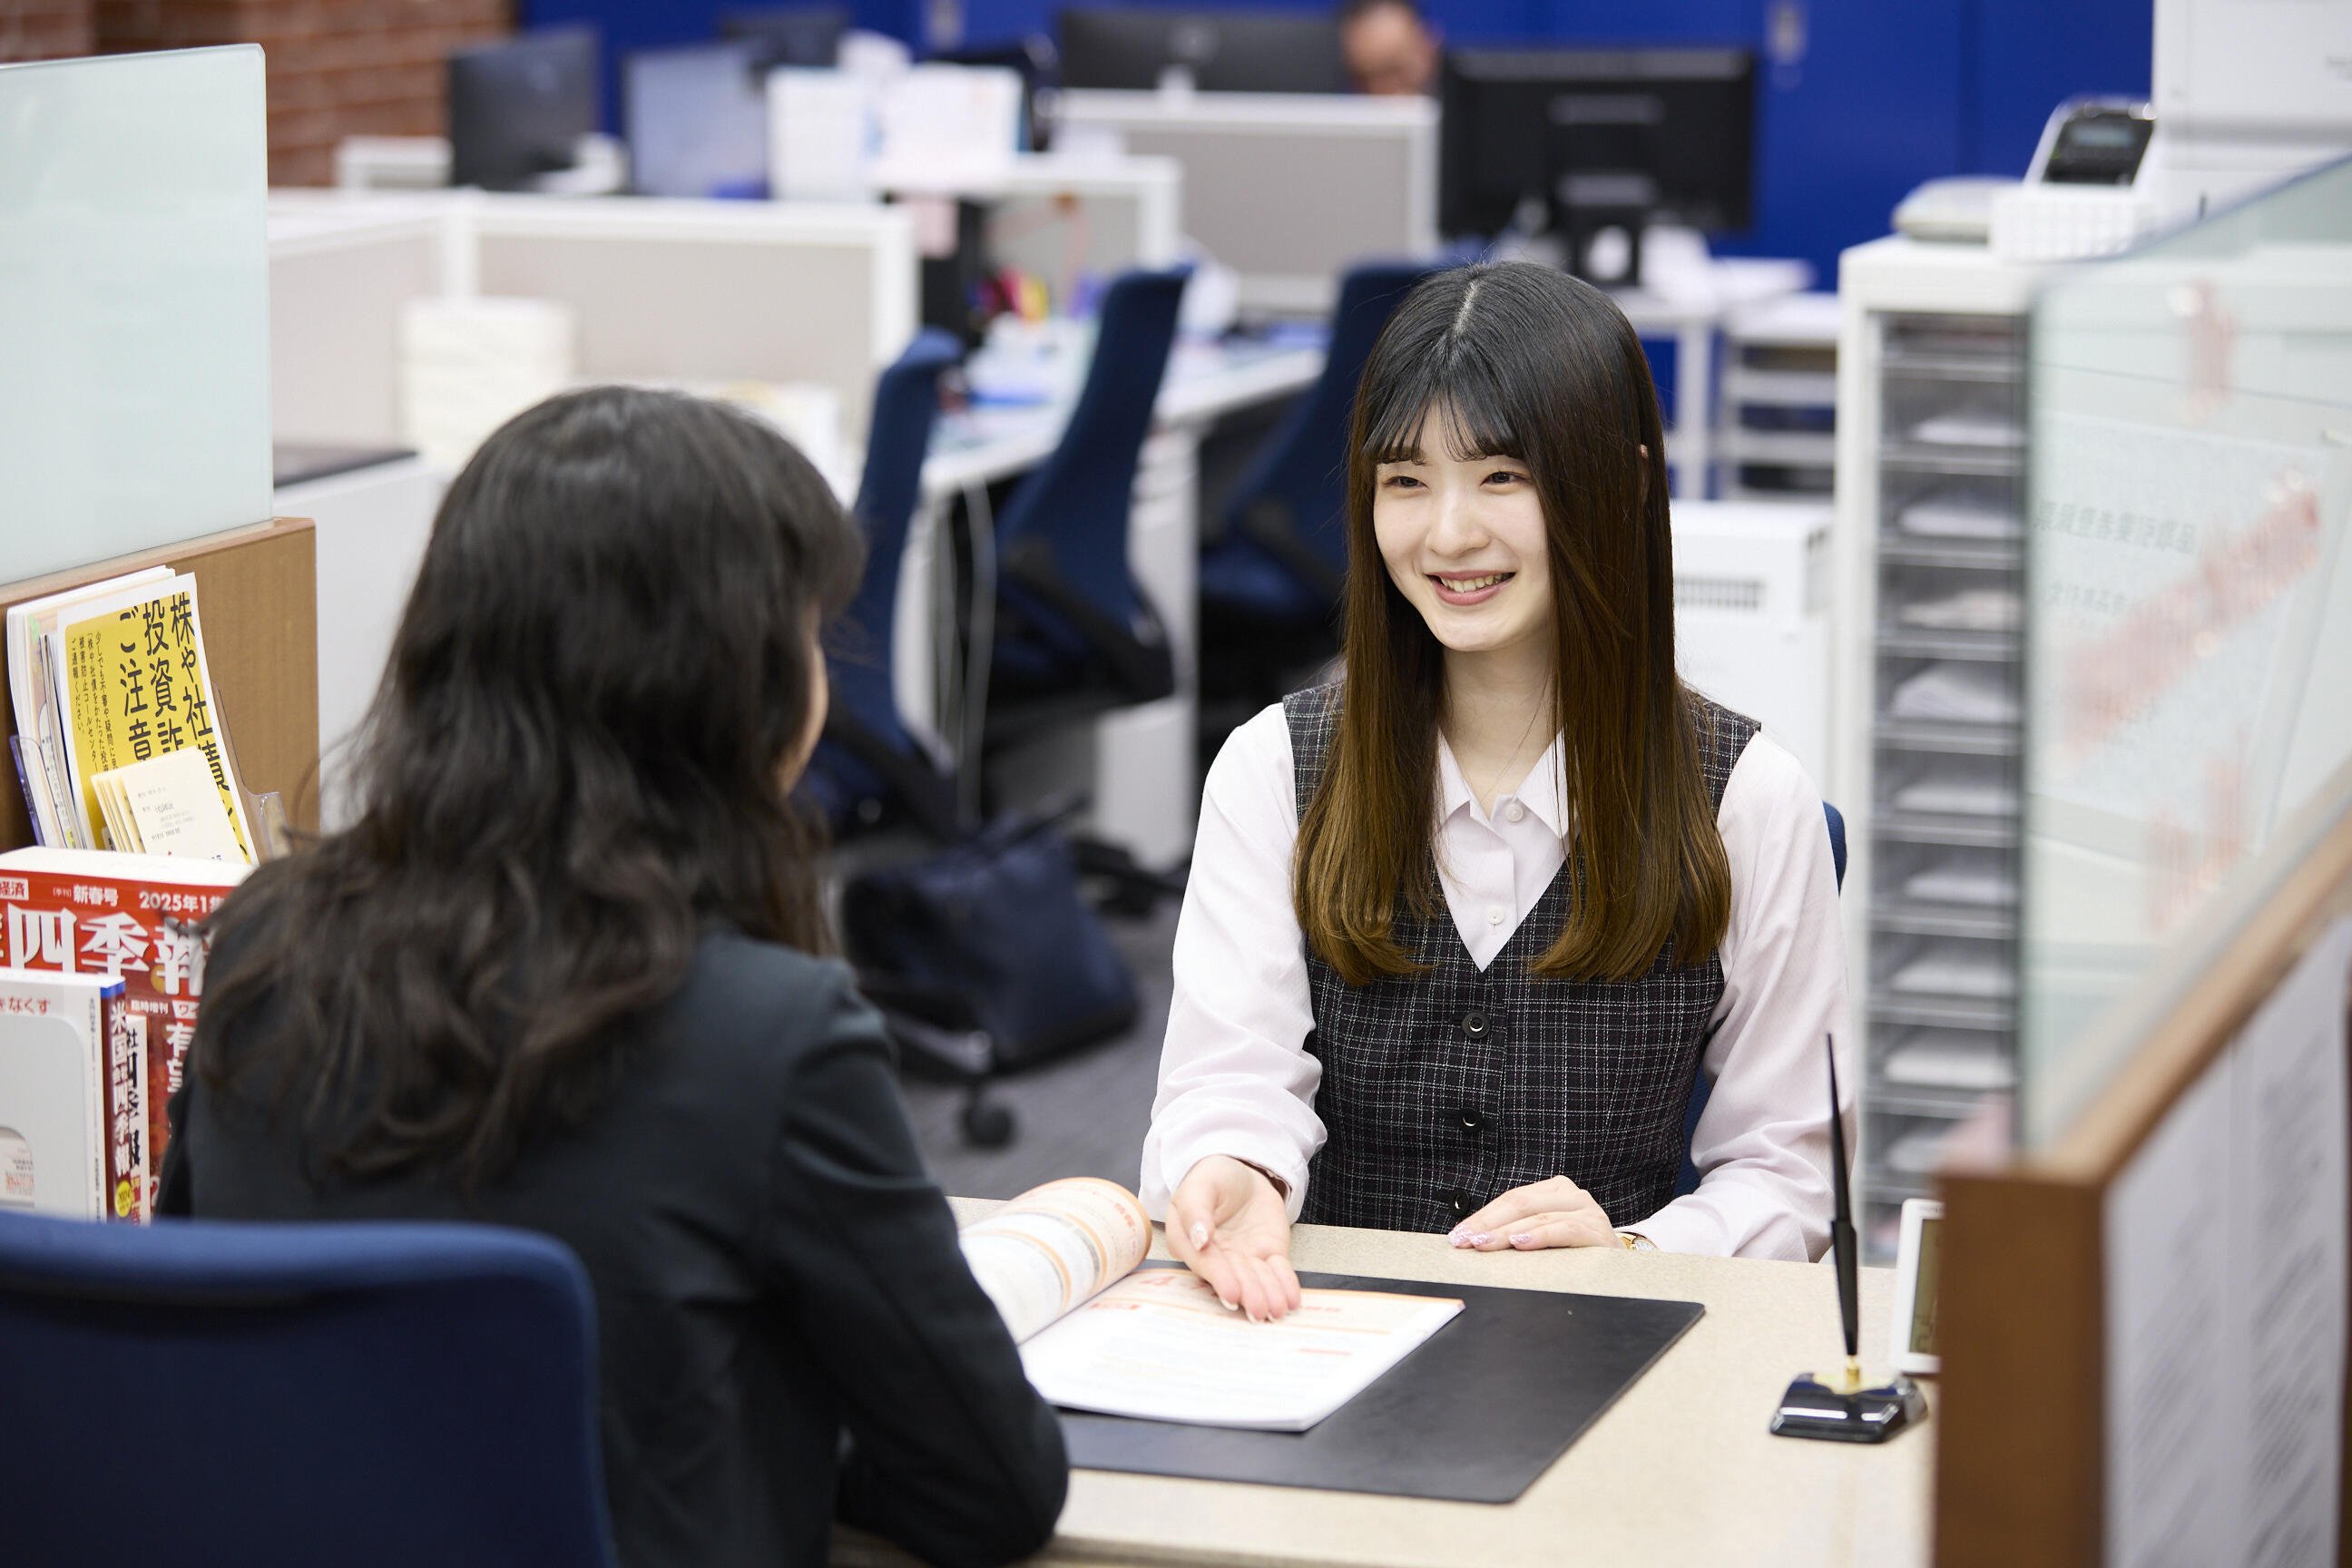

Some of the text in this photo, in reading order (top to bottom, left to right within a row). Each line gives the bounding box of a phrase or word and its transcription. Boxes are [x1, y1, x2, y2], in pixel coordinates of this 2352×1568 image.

[74, 884, 119, 906] 新春号
[0, 902, 216, 996] 四季報
[0, 996, 50, 1015] なくす
